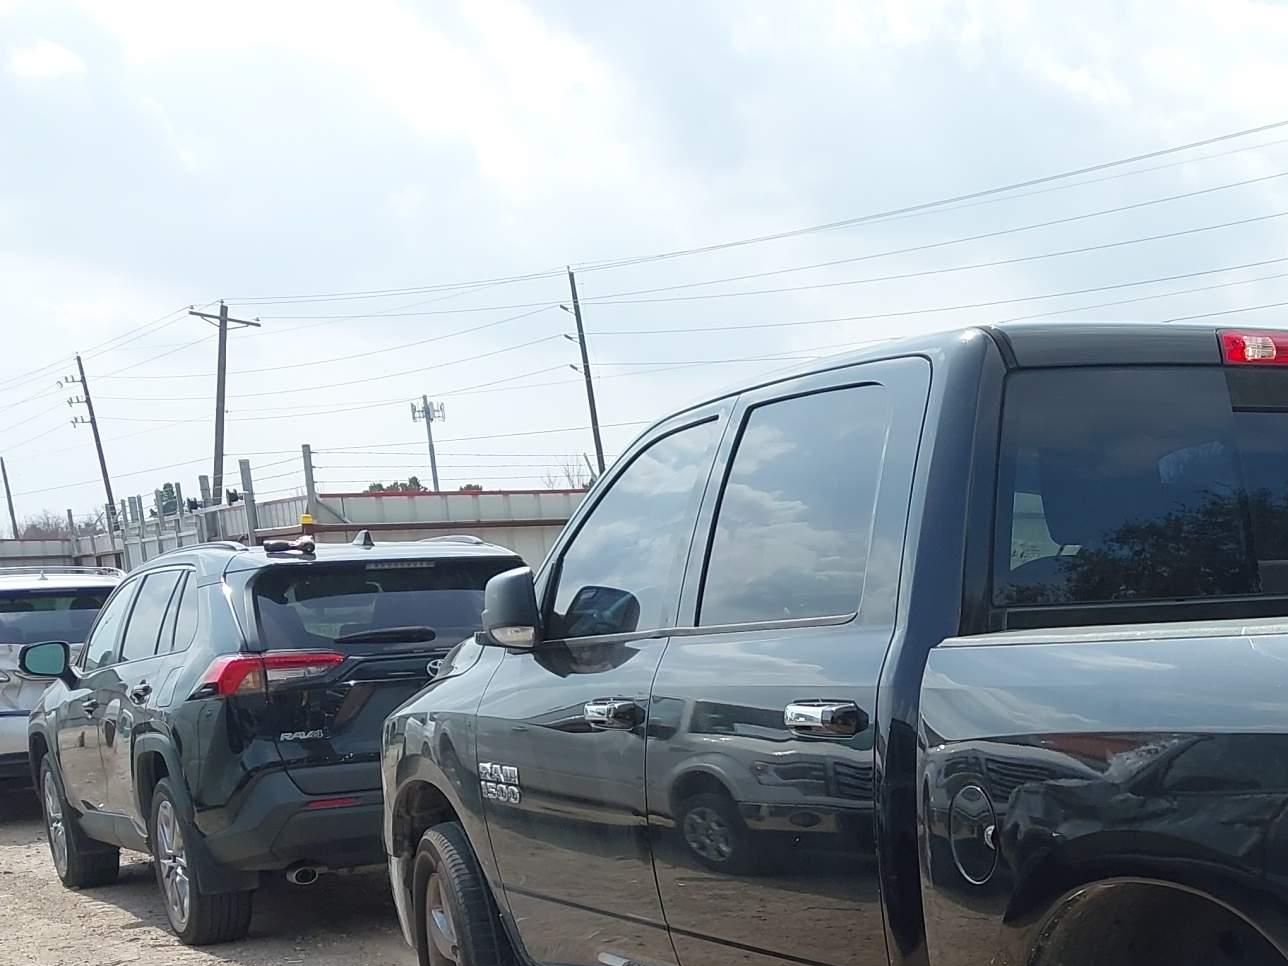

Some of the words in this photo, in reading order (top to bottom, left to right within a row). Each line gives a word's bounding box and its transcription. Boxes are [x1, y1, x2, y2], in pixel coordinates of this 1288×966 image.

[280, 729, 324, 742] RAV4
[478, 762, 519, 785] RAM
[481, 781, 521, 804] 1500
